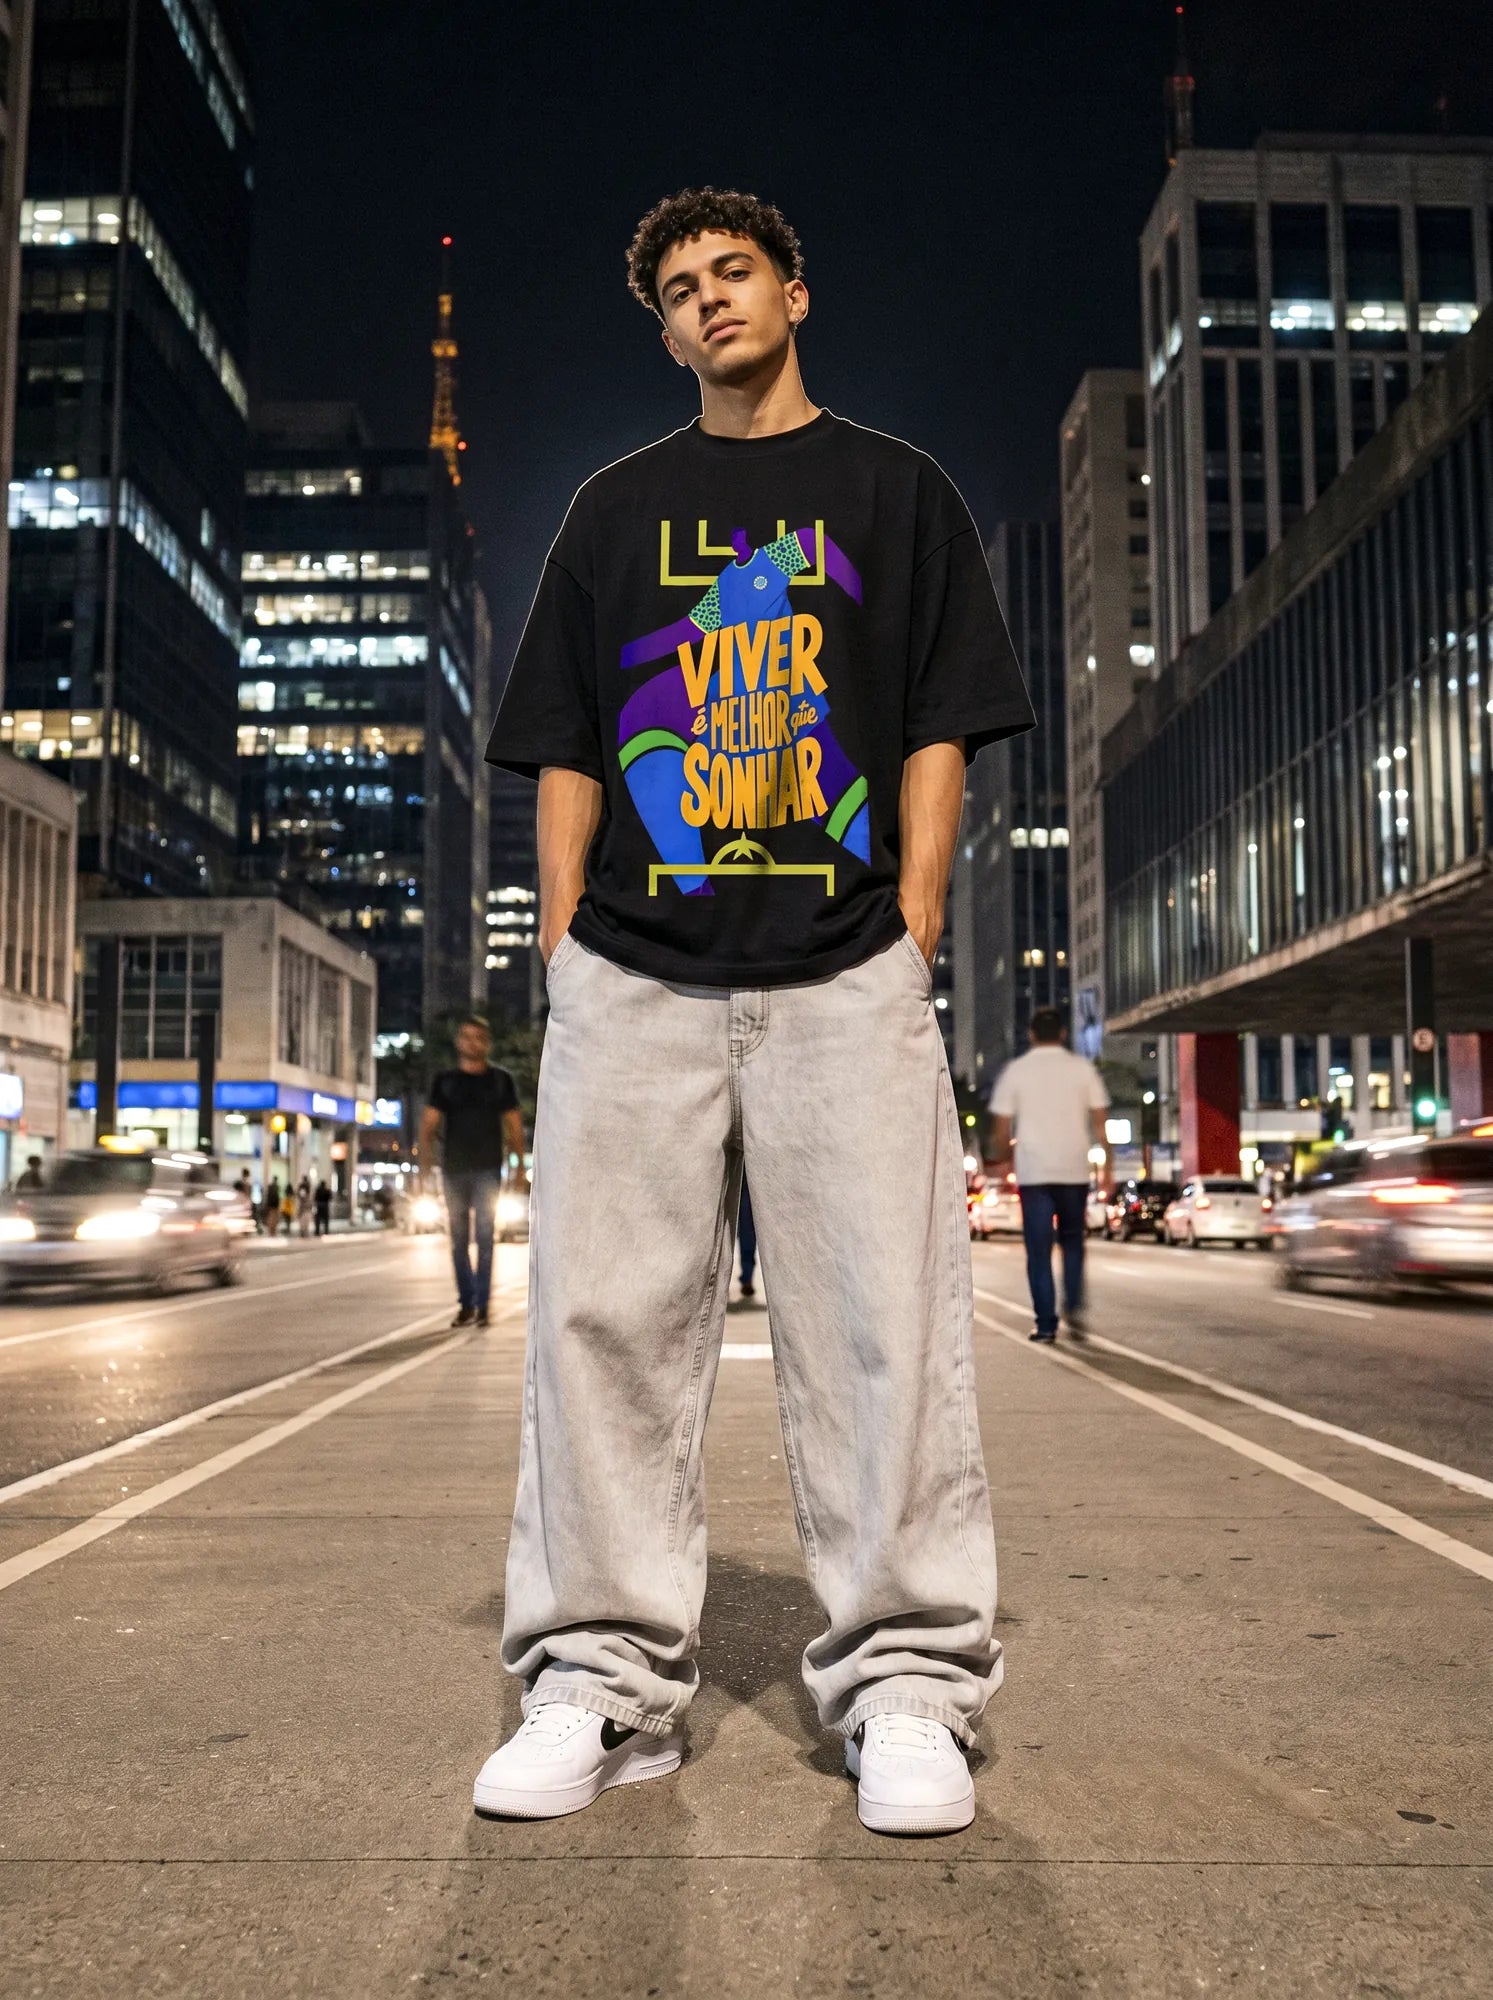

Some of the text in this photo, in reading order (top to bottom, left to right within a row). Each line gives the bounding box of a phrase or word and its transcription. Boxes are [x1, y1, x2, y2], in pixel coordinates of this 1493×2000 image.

[677, 613, 828, 708] VIVER
[690, 706, 708, 736] é
[710, 689, 792, 754] MELHOR
[680, 736, 829, 830] SONHAR
